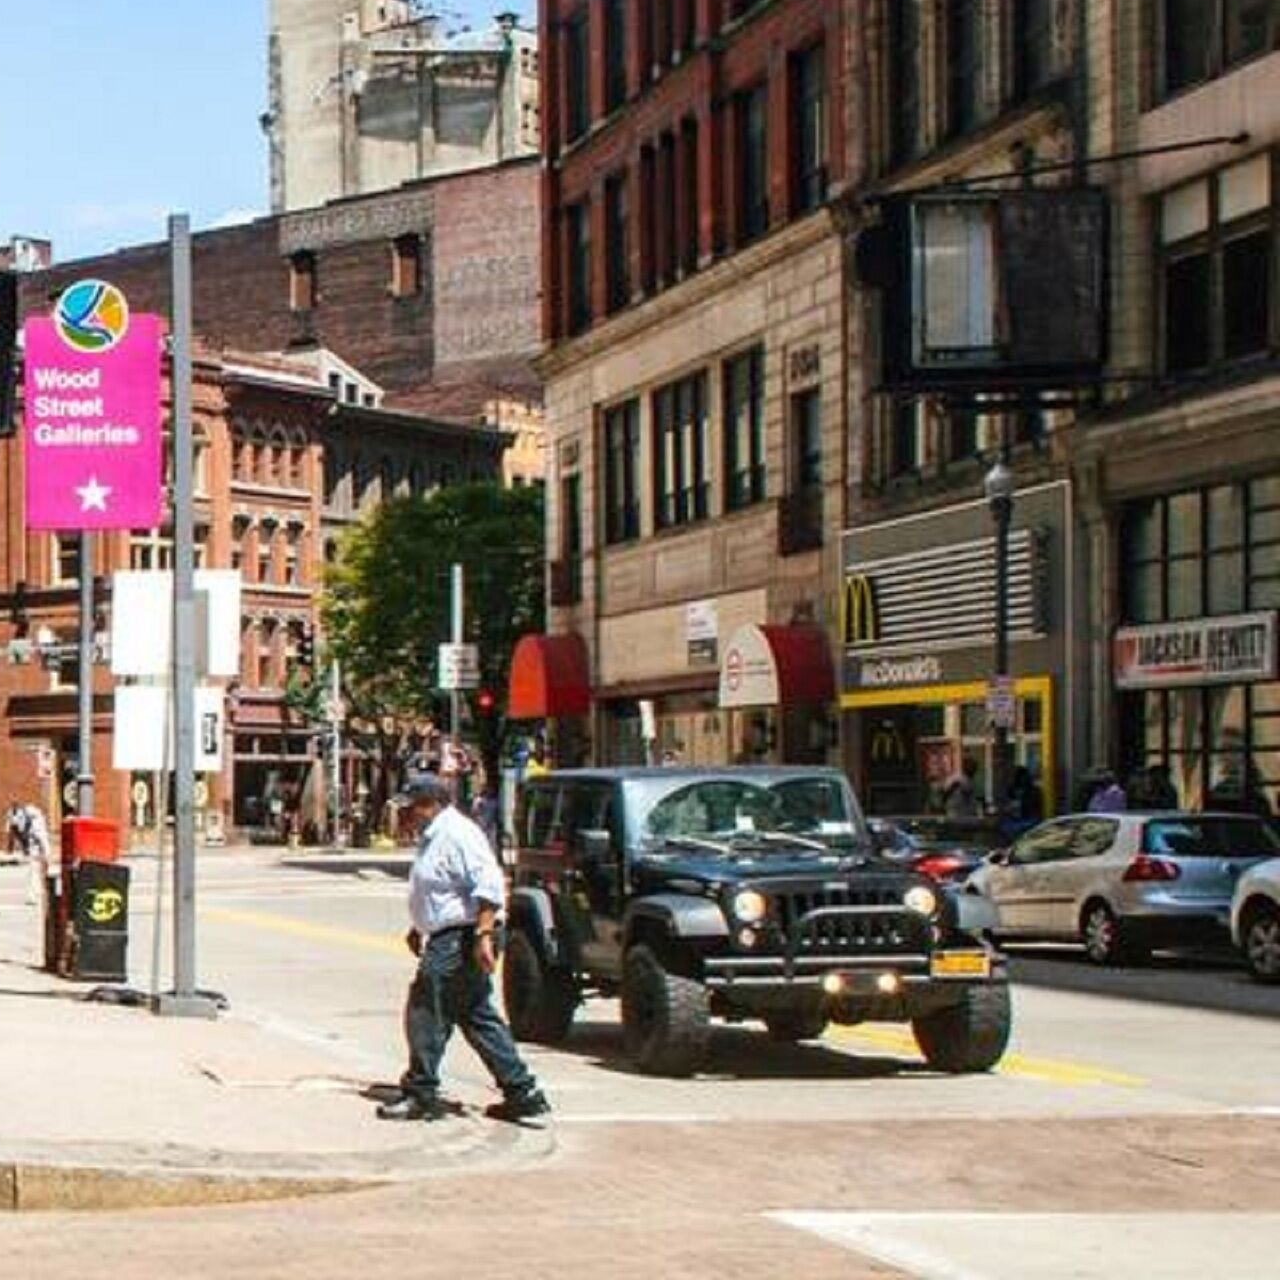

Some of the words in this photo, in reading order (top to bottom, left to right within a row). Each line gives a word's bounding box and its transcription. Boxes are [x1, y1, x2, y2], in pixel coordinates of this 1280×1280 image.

[33, 366, 100, 392] Wood
[34, 396, 104, 418] Street
[34, 422, 138, 448] Galleries
